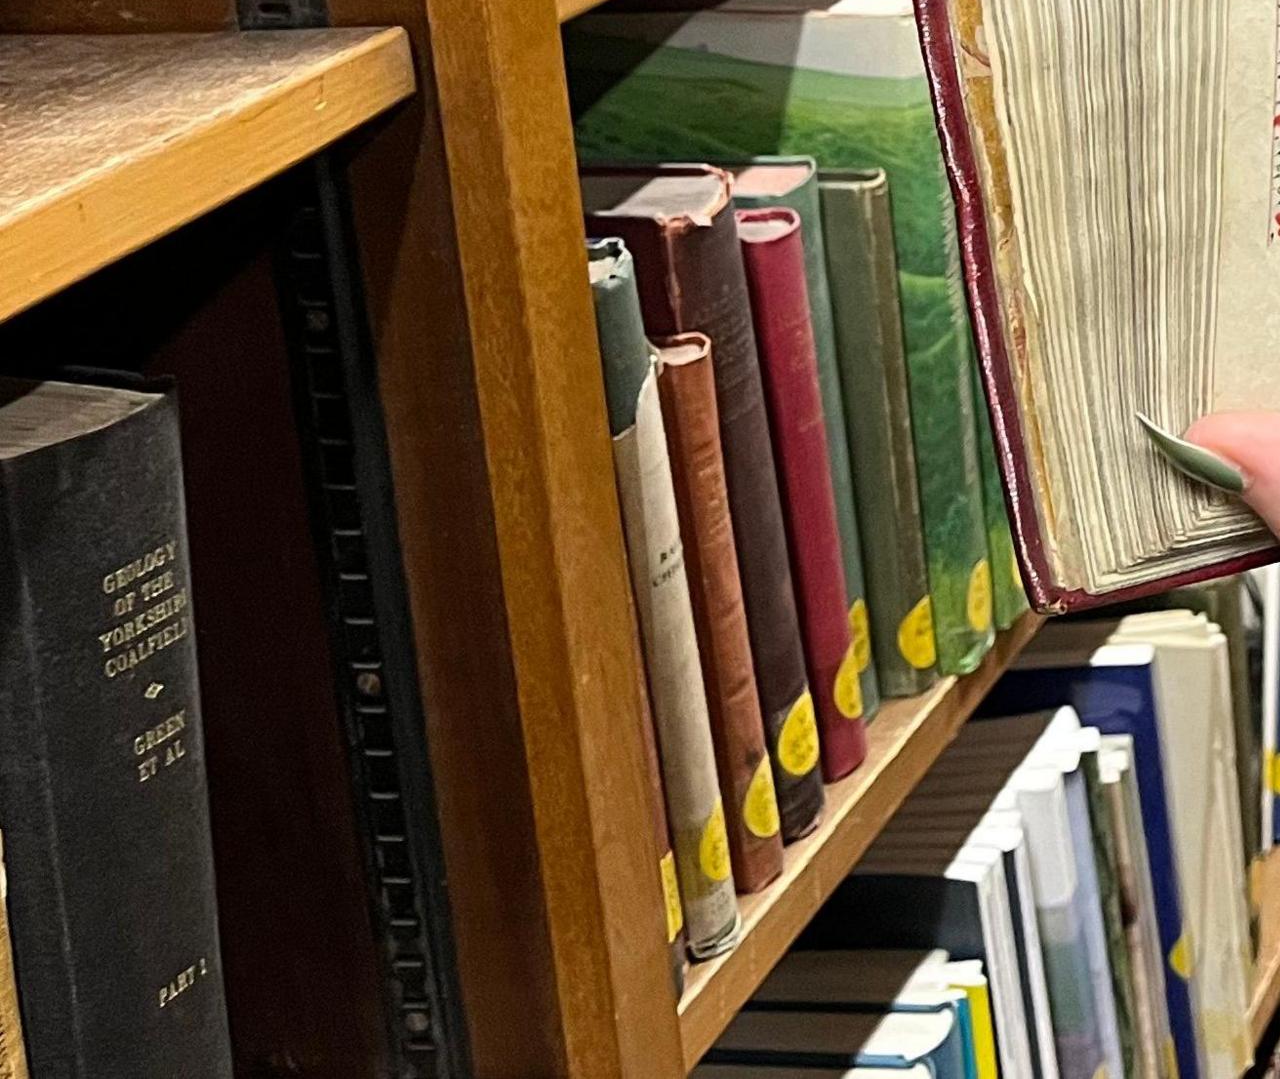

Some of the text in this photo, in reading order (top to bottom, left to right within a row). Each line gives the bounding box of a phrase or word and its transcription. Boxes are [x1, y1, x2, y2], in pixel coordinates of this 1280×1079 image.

[103, 540, 177, 594] GEOLOGY
[114, 570, 174, 617] OF THE
[98, 587, 188, 653] YORKSHIR
[104, 616, 188, 678] COALFIEL
[134, 709, 186, 756] GREEN
[138, 740, 186, 783] ET AL
[159, 964, 195, 1008] PART
